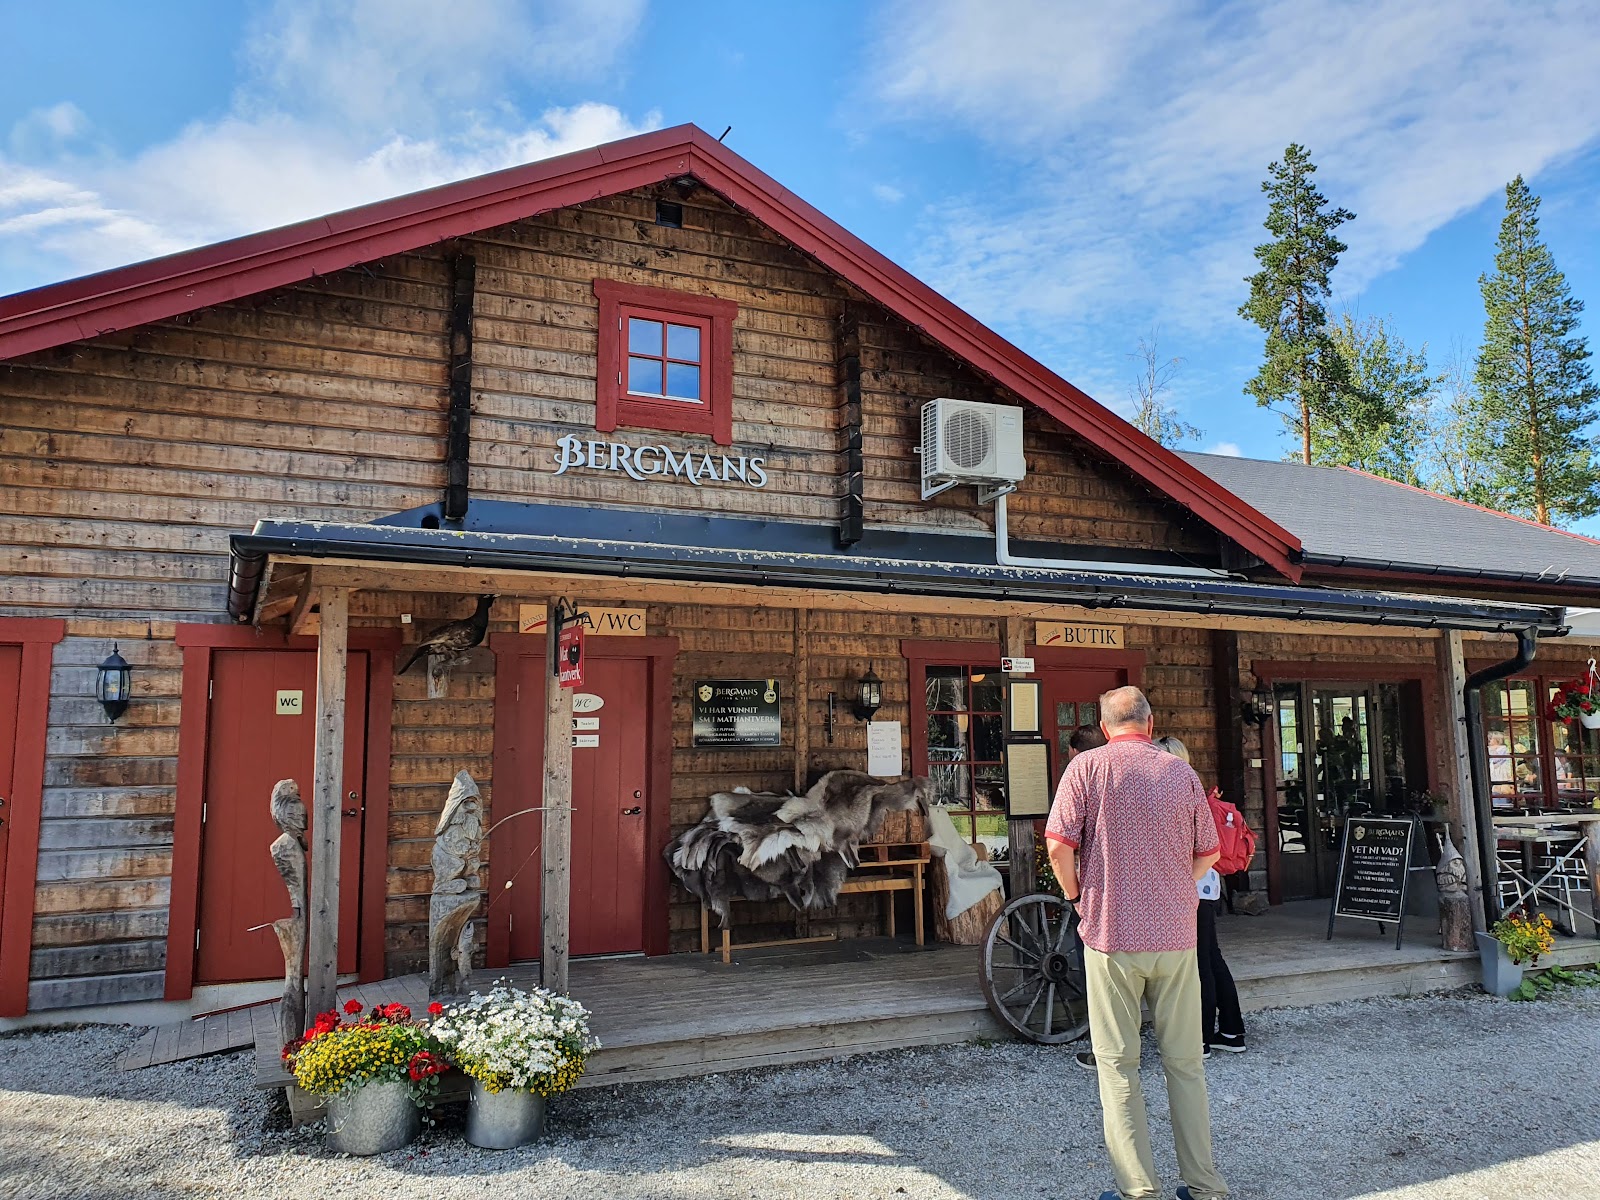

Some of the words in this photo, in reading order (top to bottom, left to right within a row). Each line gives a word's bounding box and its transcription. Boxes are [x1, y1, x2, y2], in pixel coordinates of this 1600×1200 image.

[552, 433, 768, 488] BERGMANS
[1063, 627, 1117, 645] BUTIK
[714, 687, 759, 697] BERGMANS
[280, 697, 298, 707] WC
[574, 698, 592, 708] WC
[698, 706, 707, 714] VI
[709, 706, 726, 714] HAR
[727, 706, 759, 714] VUNNIT
[1351, 845, 1368, 854] VET
[1369, 846, 1379, 854] NI
[1381, 847, 1404, 856] VAD?
